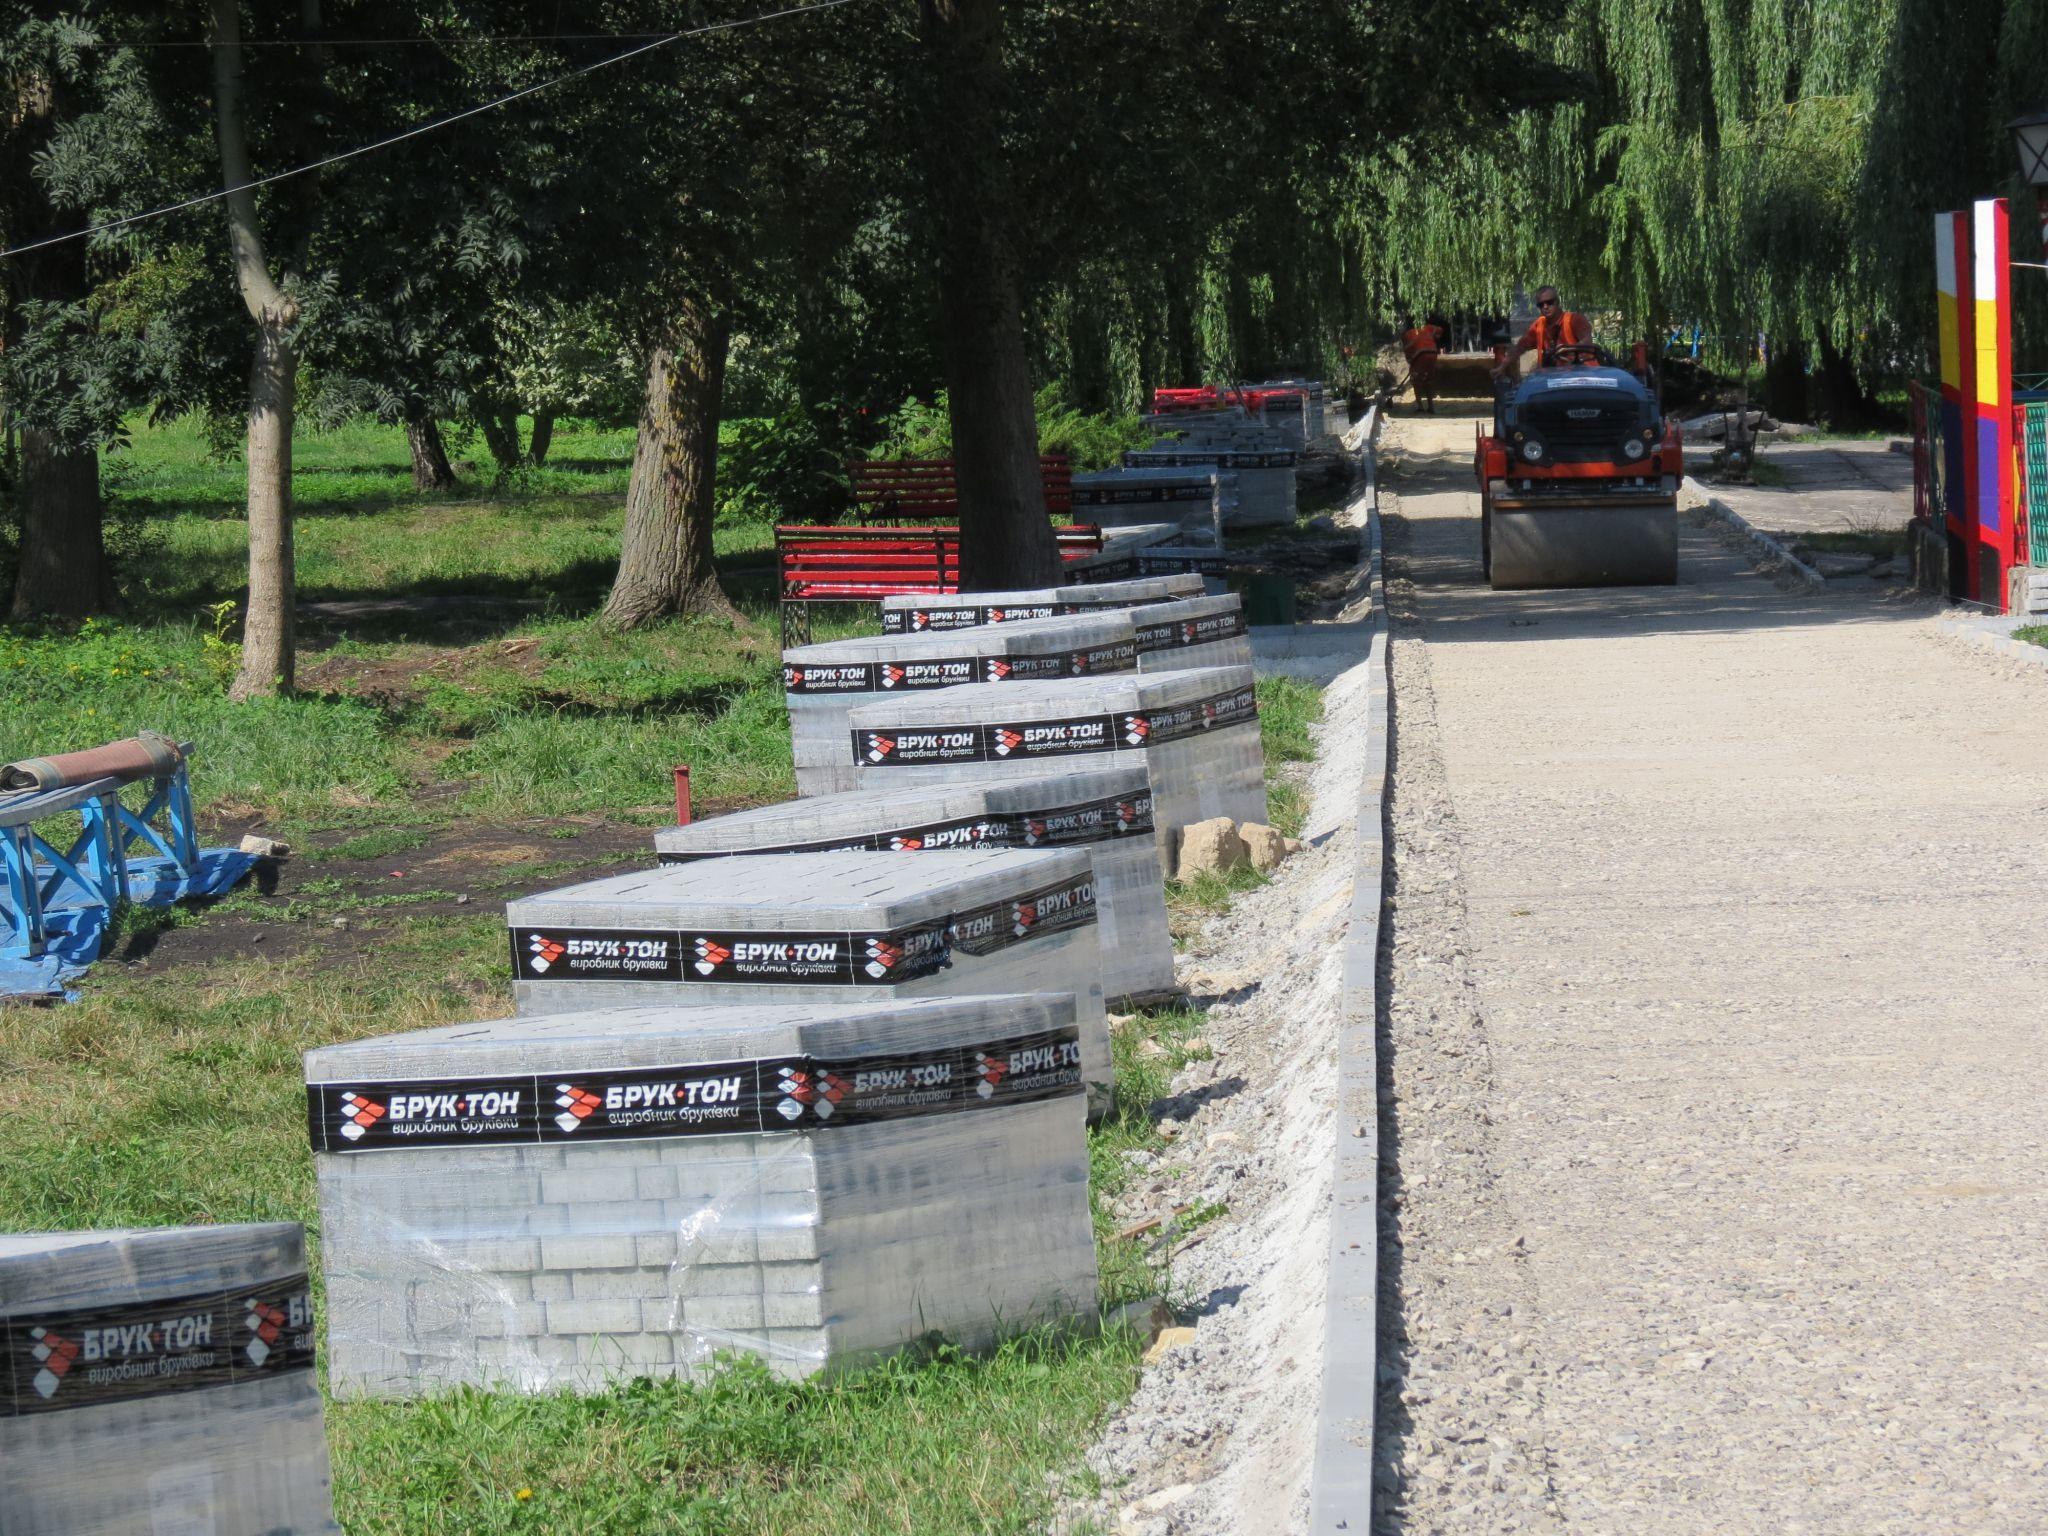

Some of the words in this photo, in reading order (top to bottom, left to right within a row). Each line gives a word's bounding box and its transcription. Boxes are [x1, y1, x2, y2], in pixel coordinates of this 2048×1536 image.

[570, 957, 620, 971] виробник
[622, 957, 668, 972] бруківки
[608, 1107, 676, 1126] виробник
[679, 1105, 739, 1123] бруківки
[393, 1118, 457, 1136] виробник
[460, 1117, 519, 1135] бруківки
[89, 1358, 156, 1386] виробник
[159, 1351, 215, 1377] бруківки
